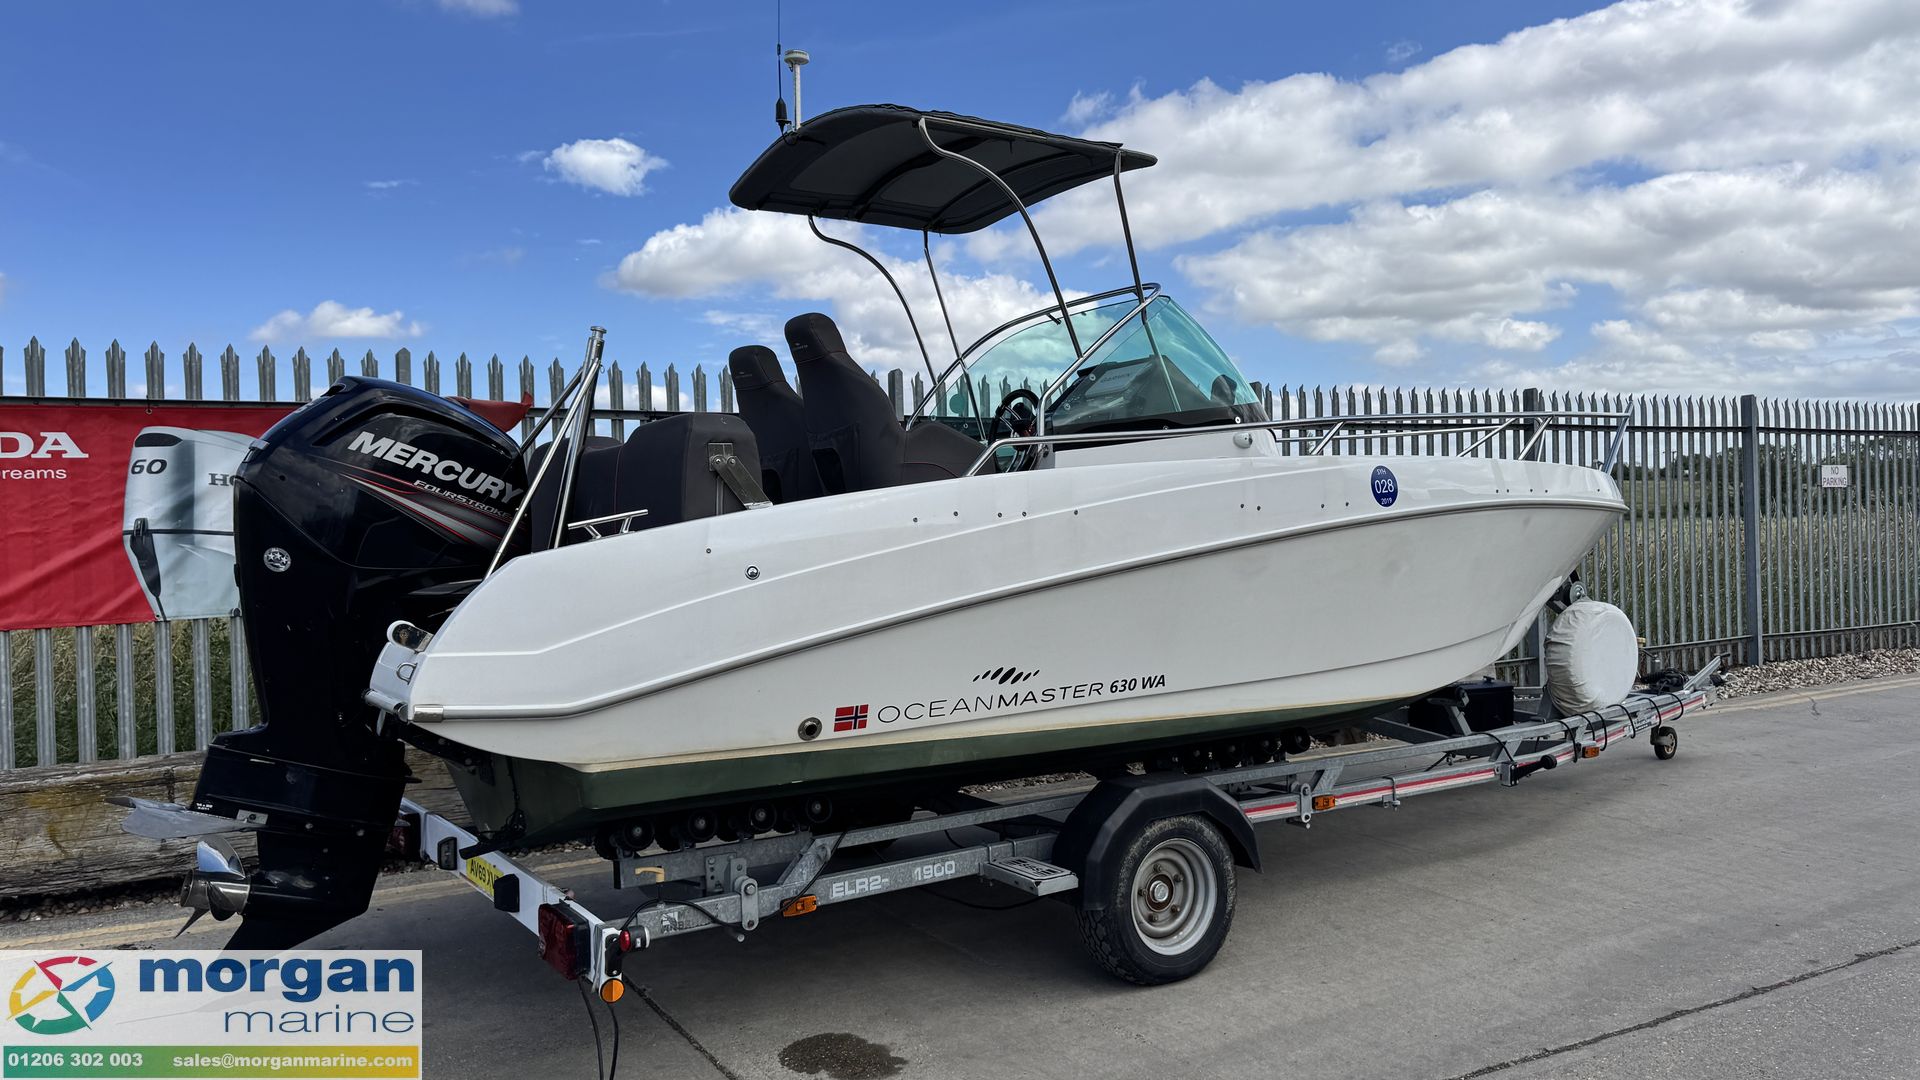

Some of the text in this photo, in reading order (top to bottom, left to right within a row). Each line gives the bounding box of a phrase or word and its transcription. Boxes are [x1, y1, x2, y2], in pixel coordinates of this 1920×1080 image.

[0, 469, 67, 480] reams
[130, 458, 168, 475] 60
[347, 431, 524, 503] MERCURY
[1830, 466, 1839, 475] NO
[1374, 478, 1394, 493] 028
[1823, 476, 1847, 486] PARKING
[413, 479, 512, 518] FOURSTROKE
[877, 674, 1166, 723] OCEANMASTER 630 WA
[913, 860, 956, 881] 1900
